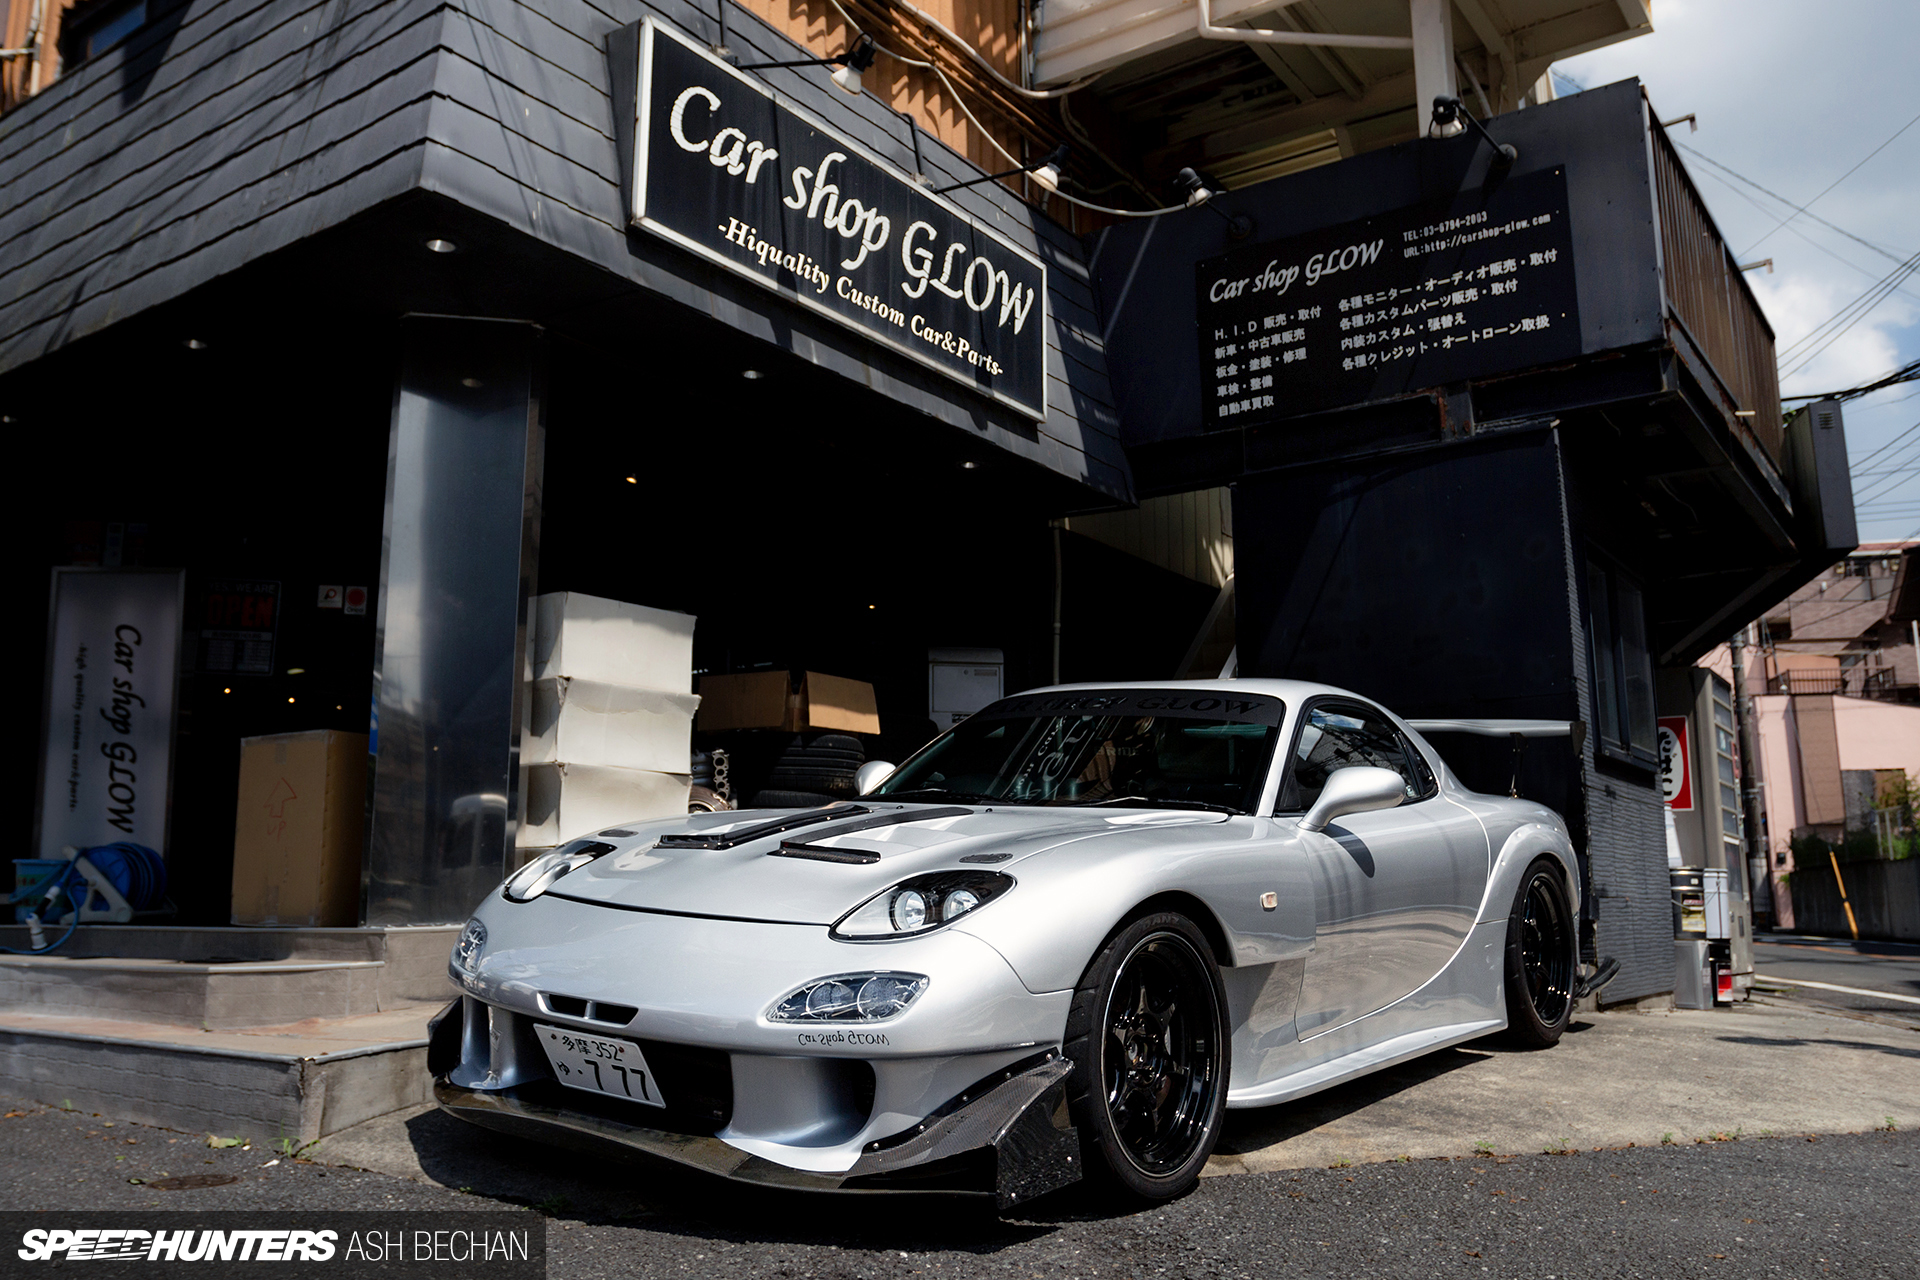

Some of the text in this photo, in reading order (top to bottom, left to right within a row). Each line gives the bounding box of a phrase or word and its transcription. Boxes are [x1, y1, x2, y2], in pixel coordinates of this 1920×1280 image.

[670, 86, 1034, 335] Car shop GLOW
[1209, 238, 1384, 303] Car shop GLOW
[836, 274, 905, 327] Custom
[1339, 277, 1519, 331] 各種カスタムパーツ販売・取付
[1214, 328, 1306, 359] 新車・中古車販売
[1341, 311, 1467, 351] 内装カスタム・張替え
[1218, 395, 1274, 417] 自動車買取
[206, 593, 274, 628] OPEN
[1136, 696, 1265, 714] GLOW
[100, 624, 145, 833] Car shop GLOW
[562, 1035, 623, 1062] 多摩 352
